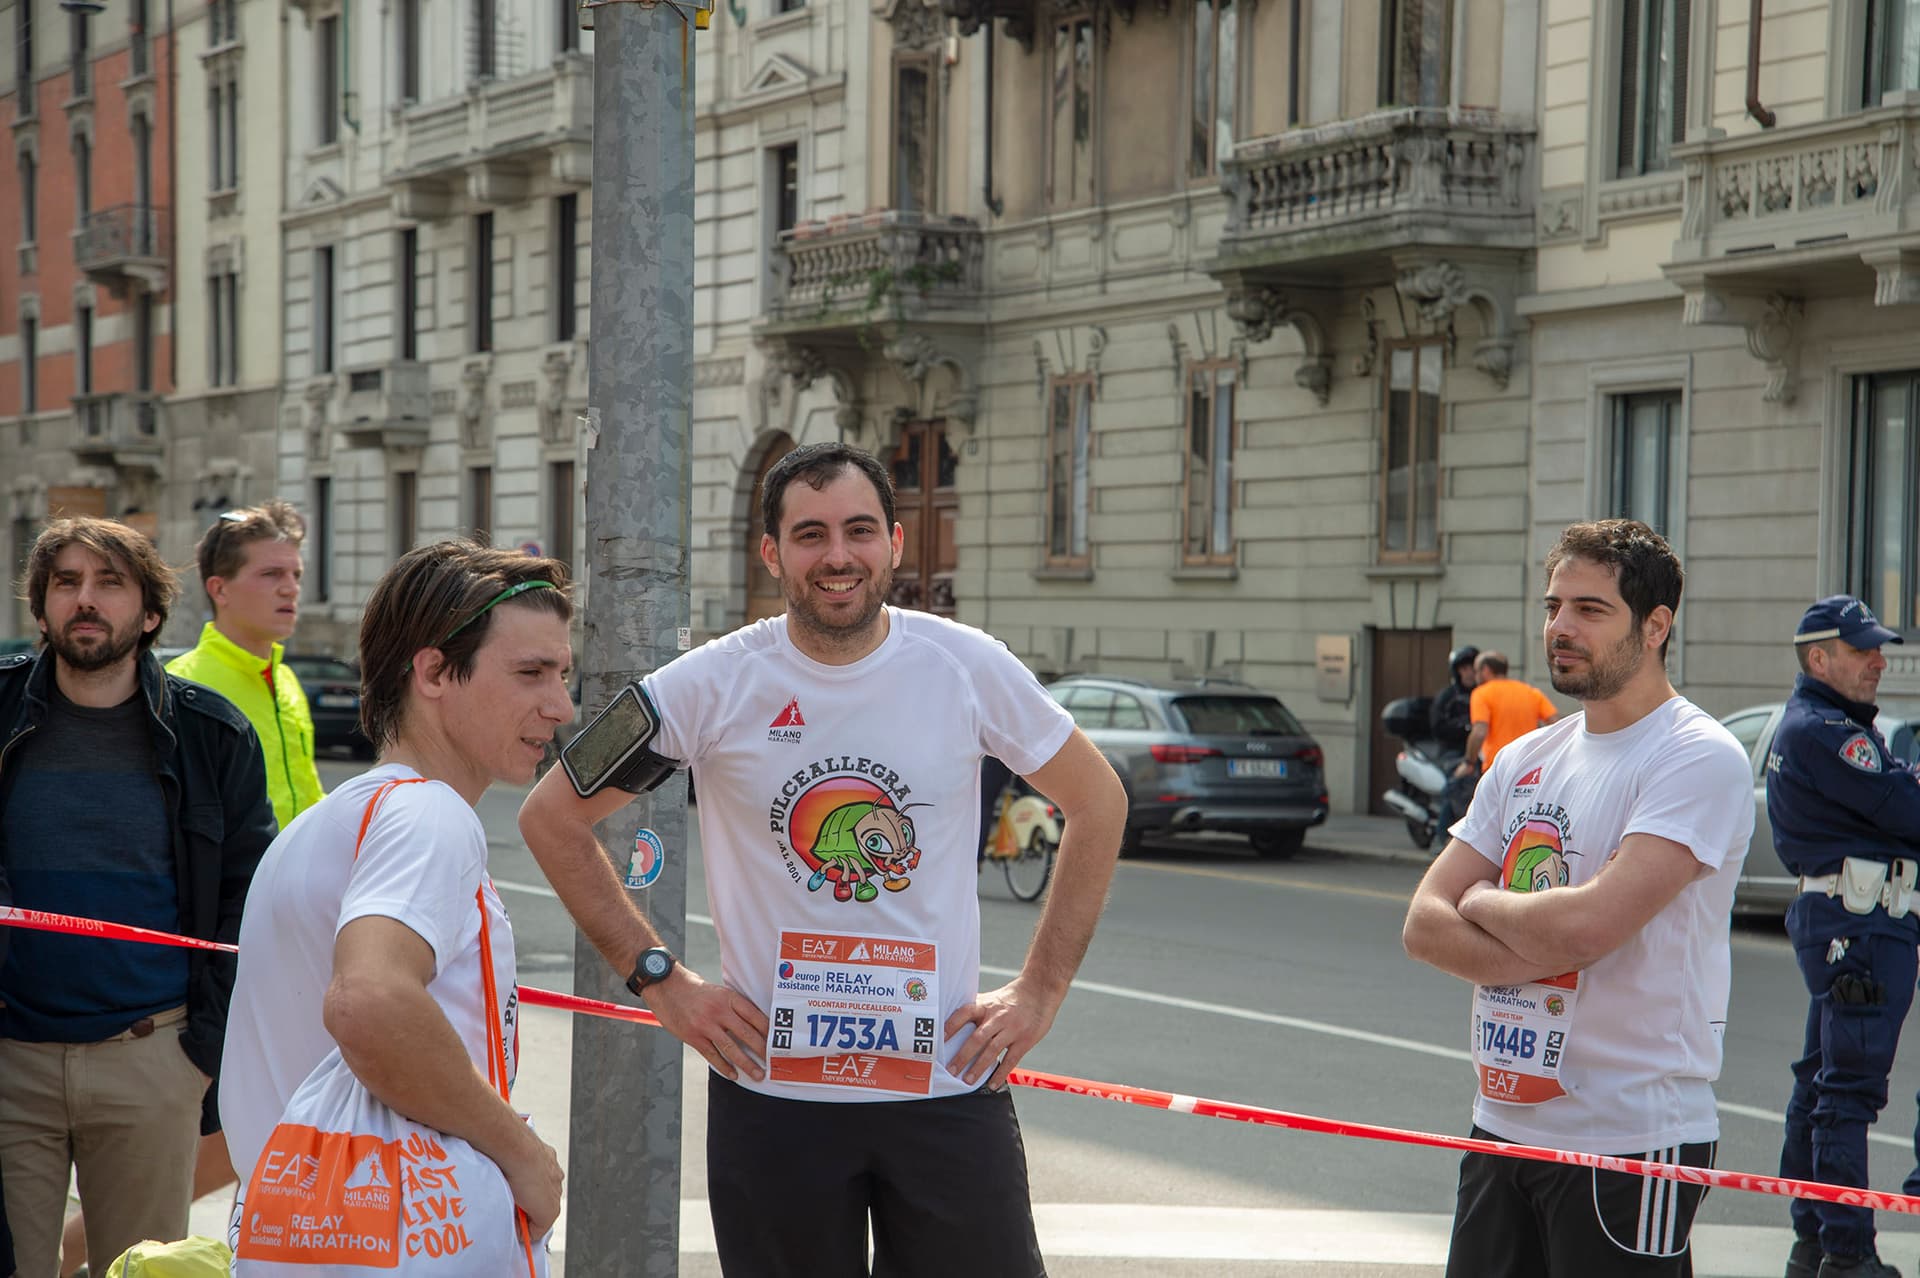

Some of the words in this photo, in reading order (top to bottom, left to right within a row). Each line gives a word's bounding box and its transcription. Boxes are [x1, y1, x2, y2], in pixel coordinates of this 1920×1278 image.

[768, 737, 800, 745] MARATHON
[769, 729, 802, 739] MILANO
[770, 756, 911, 833] PULCEALLEGRA
[628, 876, 646, 886] PIN
[30, 911, 104, 932] MARATHON
[802, 938, 838, 955] EA7
[873, 944, 915, 957] MILANO
[873, 953, 915, 964] MARATHON
[795, 972, 820, 983] europ
[826, 971, 873, 985] RELAY
[778, 980, 820, 992] assistance
[825, 983, 895, 997] MARATHON
[808, 1000, 847, 1009] VOLONTARI
[848, 1002, 902, 1013] PULCEALLEGRA
[1489, 994, 1537, 1010] MARATHON
[807, 1014, 899, 1051] 1753A
[1482, 1021, 1537, 1059] 1744B
[822, 1055, 879, 1078] EA7
[1487, 1069, 1520, 1094] EA7
[261, 1150, 320, 1190] EA7
[344, 1190, 390, 1204] MILANO
[402, 1192, 468, 1229] LIVE
[262, 1223, 284, 1235] europ
[291, 1213, 344, 1230] RELAY
[289, 1233, 391, 1253] MARATHON
[405, 1222, 475, 1259] COOL
